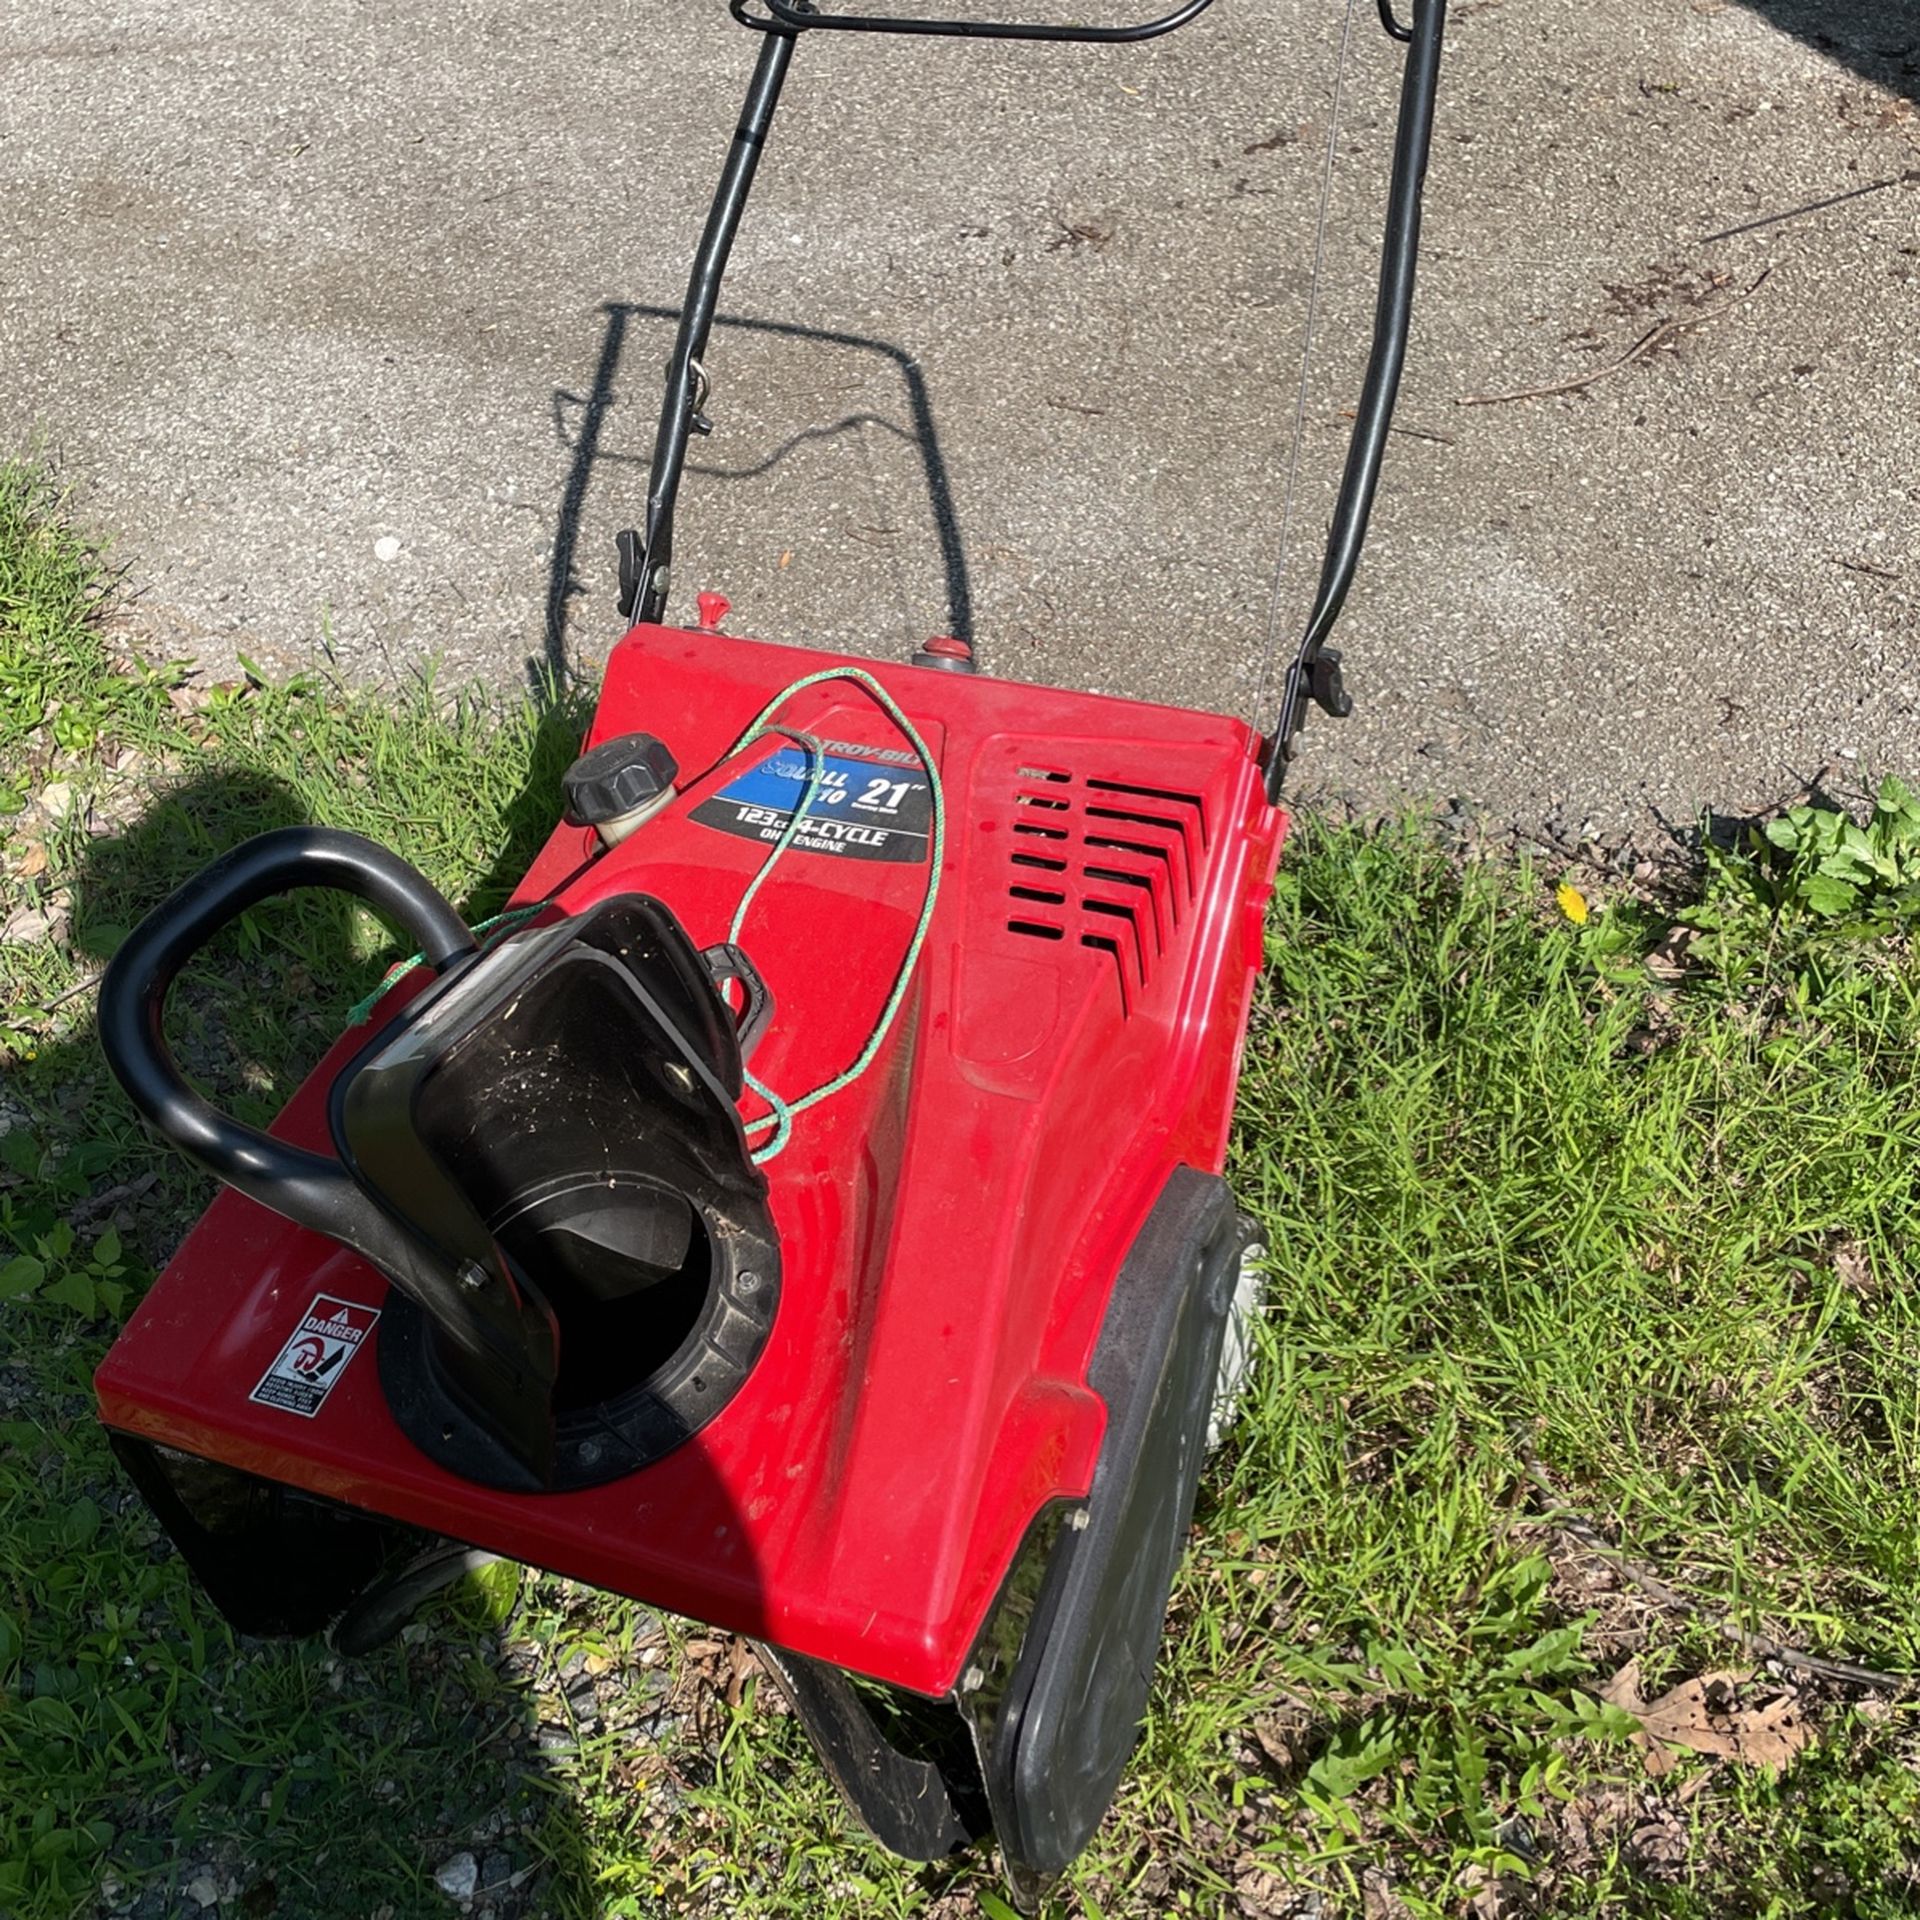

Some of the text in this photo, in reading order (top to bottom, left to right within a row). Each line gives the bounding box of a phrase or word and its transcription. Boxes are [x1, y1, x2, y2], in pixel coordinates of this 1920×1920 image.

[760, 827, 847, 853] OH ENGINE
[797, 819, 889, 847] 4-CYCLE
[303, 1316, 363, 1343] DANGER
